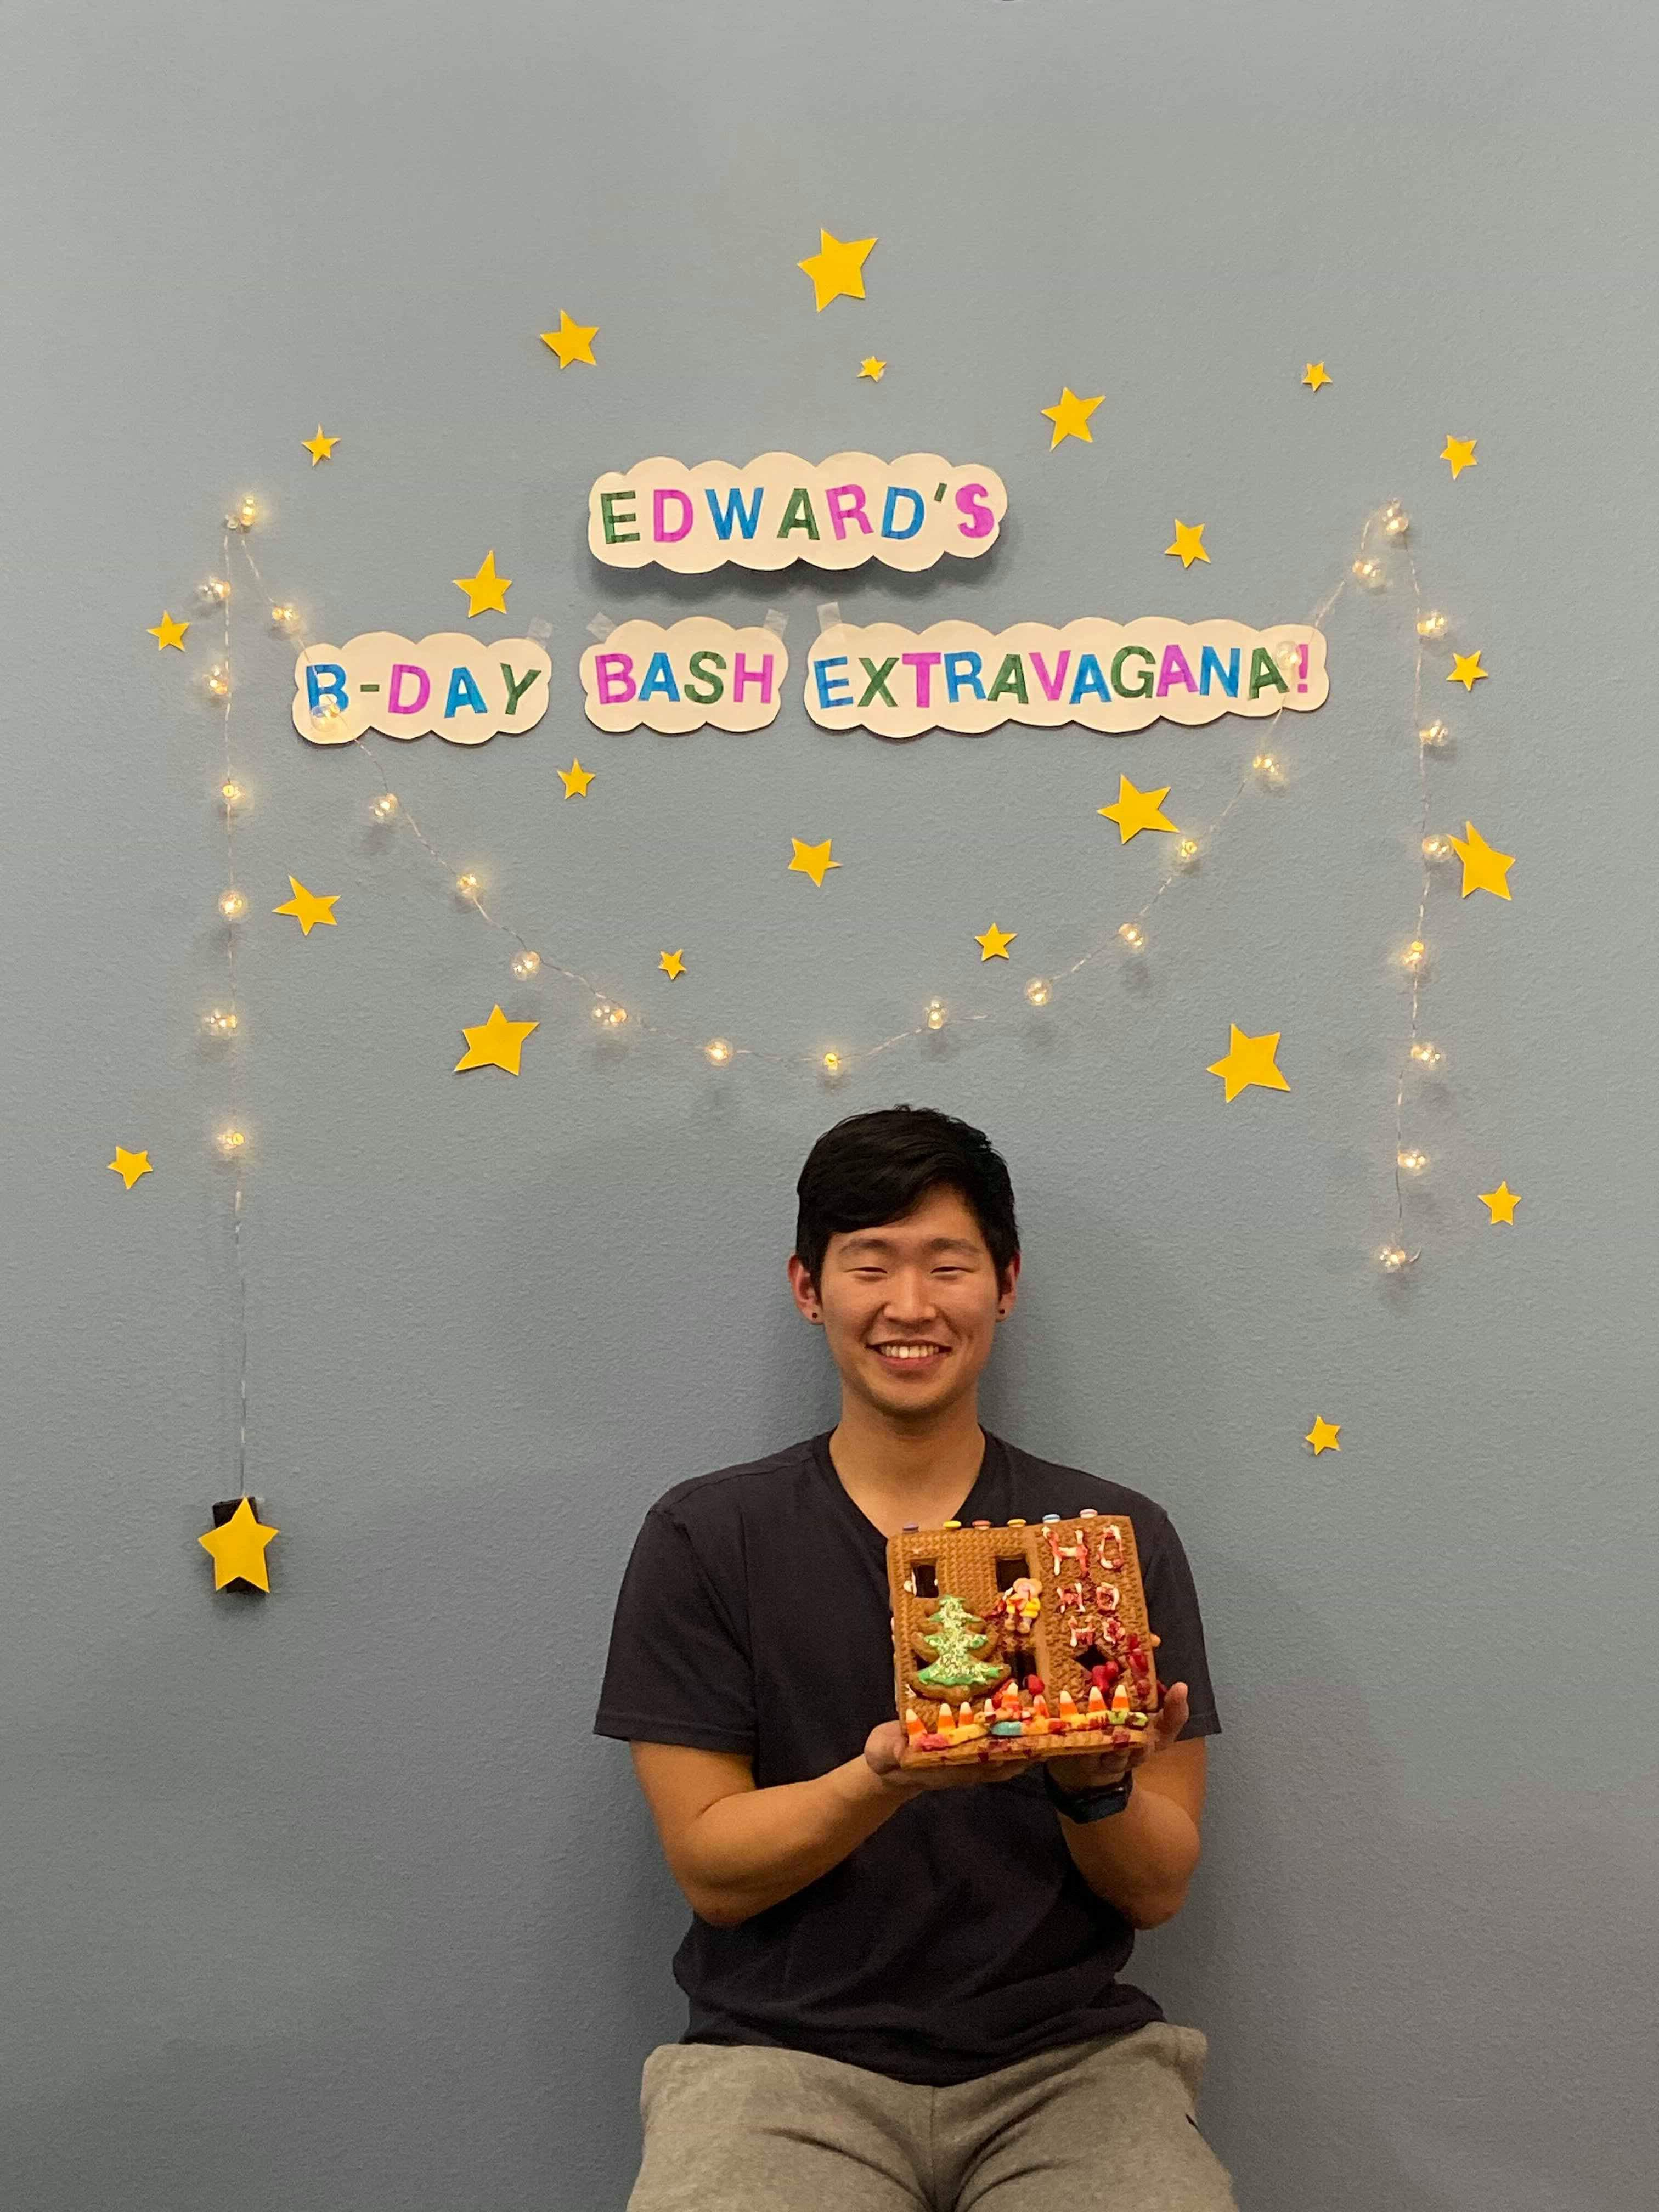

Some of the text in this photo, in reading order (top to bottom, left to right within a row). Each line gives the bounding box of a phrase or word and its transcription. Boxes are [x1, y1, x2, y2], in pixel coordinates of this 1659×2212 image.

[600, 483, 995, 544] EDWARD'S
[306, 644, 1309, 719] B-DAY BASH EXTRAVAGANA!
